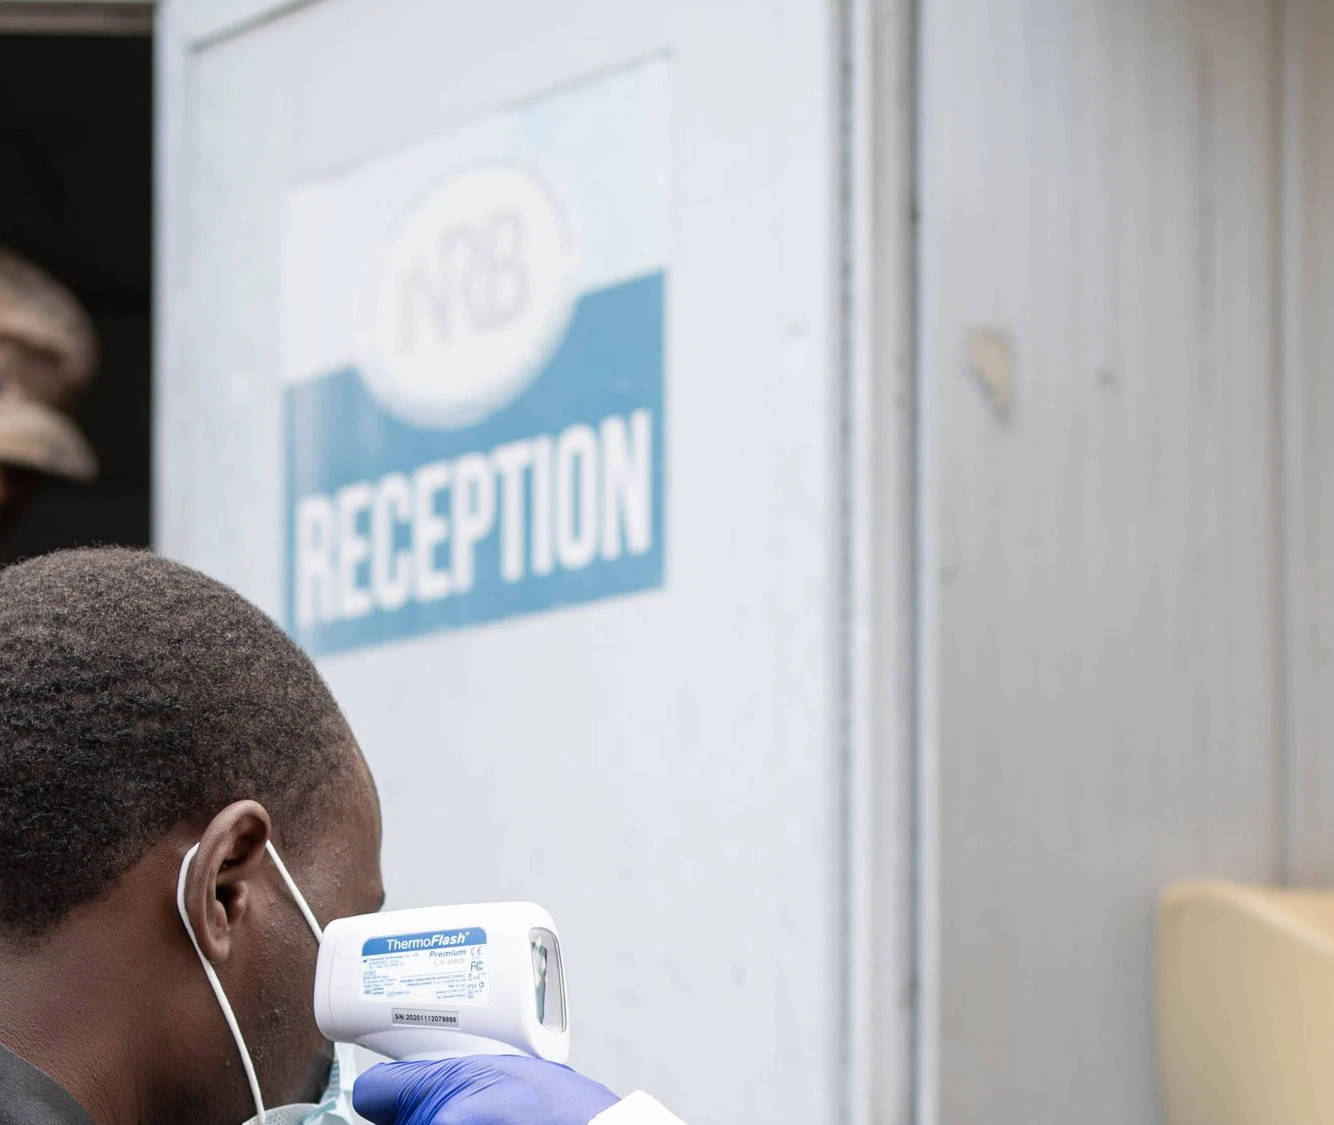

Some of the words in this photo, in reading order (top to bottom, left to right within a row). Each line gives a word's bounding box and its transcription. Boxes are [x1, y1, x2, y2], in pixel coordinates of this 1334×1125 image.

[294, 408, 653, 630] RECEPTION
[386, 932, 466, 950] ThermoFlash
[429, 948, 467, 959] Premium
